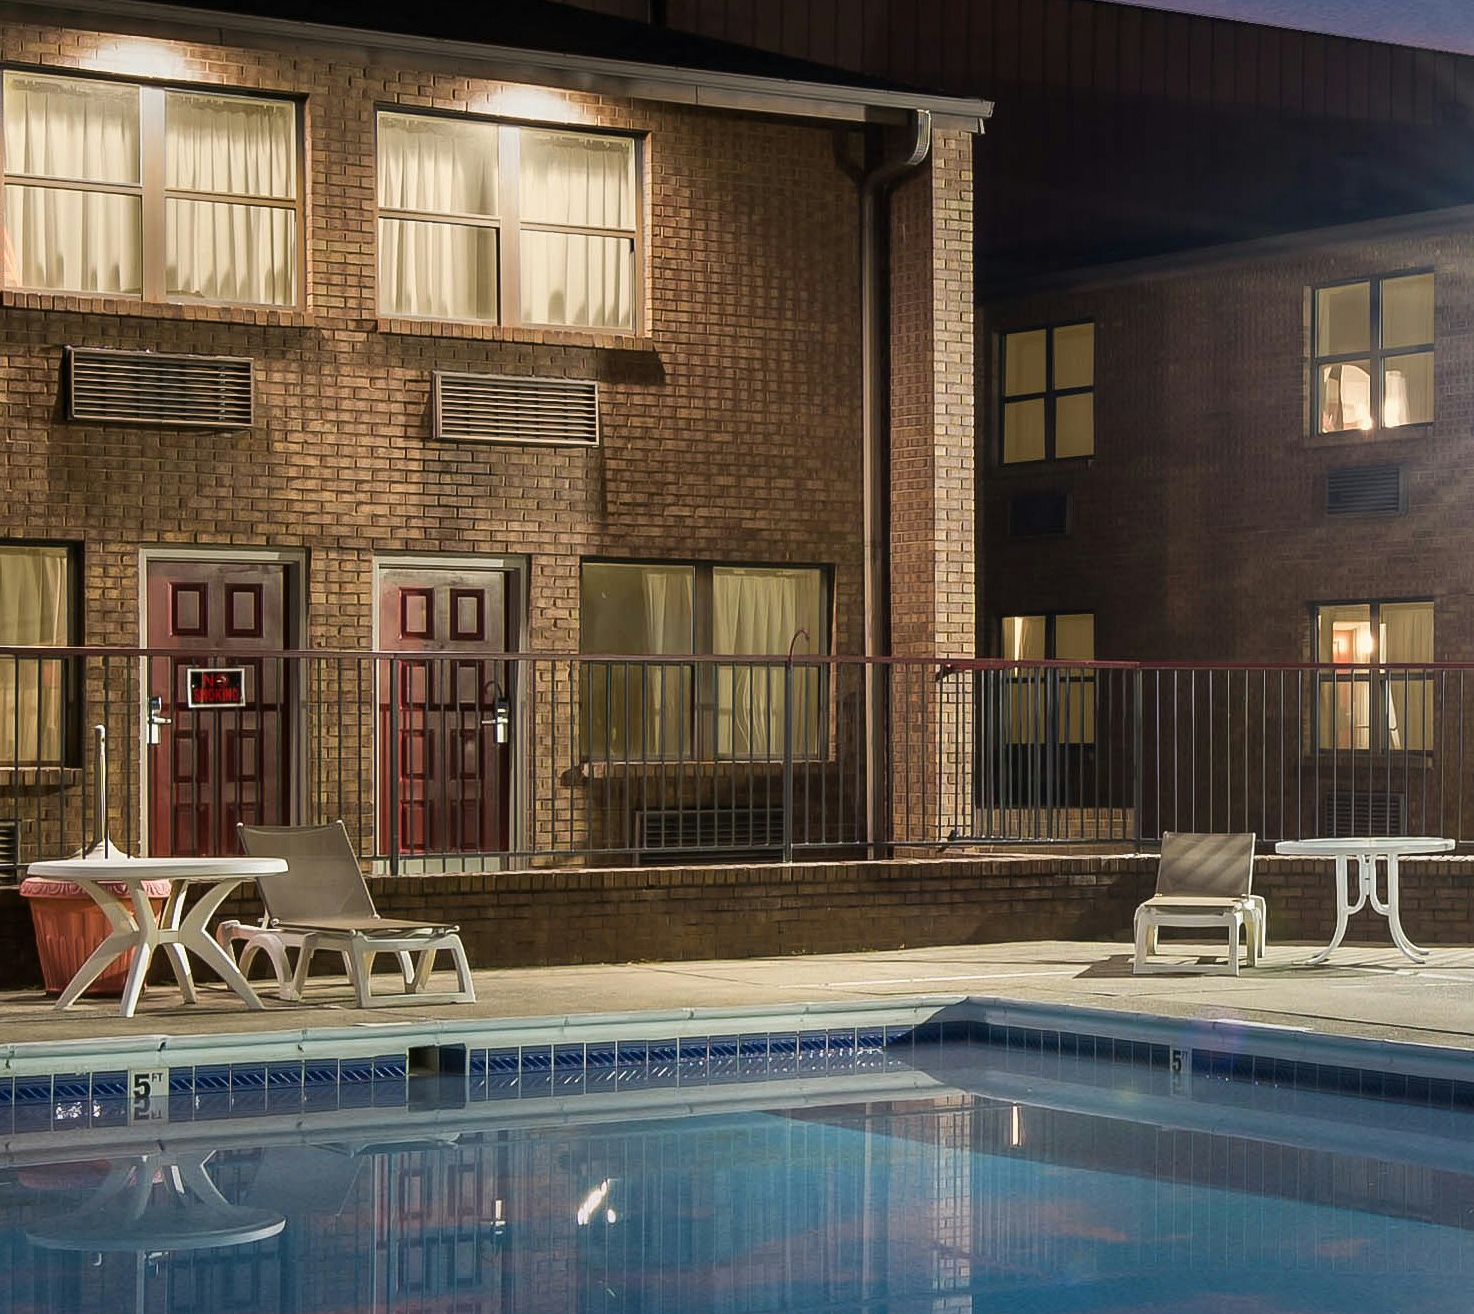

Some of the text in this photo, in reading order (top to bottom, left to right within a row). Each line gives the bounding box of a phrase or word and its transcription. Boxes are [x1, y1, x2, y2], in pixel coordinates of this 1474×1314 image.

[1172, 1050, 1182, 1071] 5
[133, 1072, 163, 1098] 5 FT
